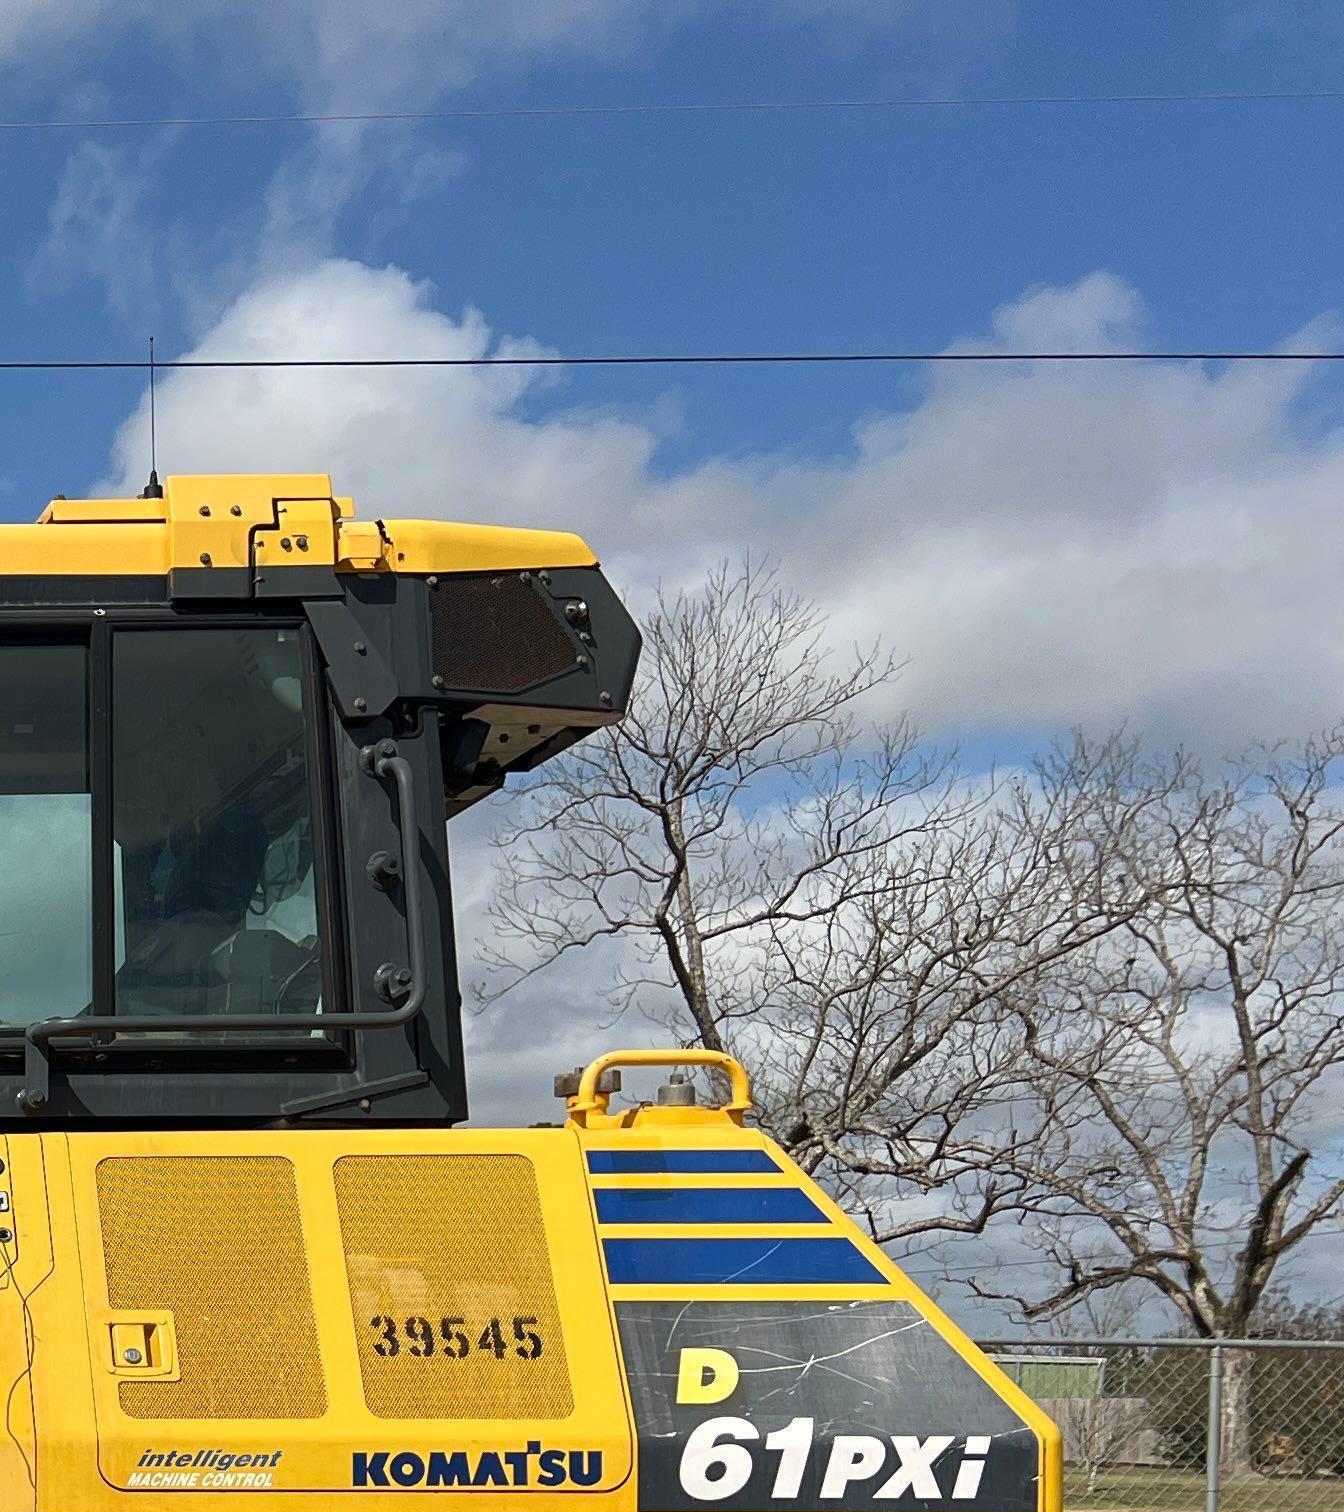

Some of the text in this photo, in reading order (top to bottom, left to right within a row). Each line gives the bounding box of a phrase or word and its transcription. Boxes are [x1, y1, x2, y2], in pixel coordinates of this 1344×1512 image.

[370, 1315, 543, 1360] 39545
[677, 1347, 739, 1404] D
[127, 1473, 273, 1487] MACHINE CONTROL
[137, 1449, 283, 1471] intelligent
[352, 1440, 603, 1487] KOMATSU
[679, 1416, 992, 1500] 61PXi
